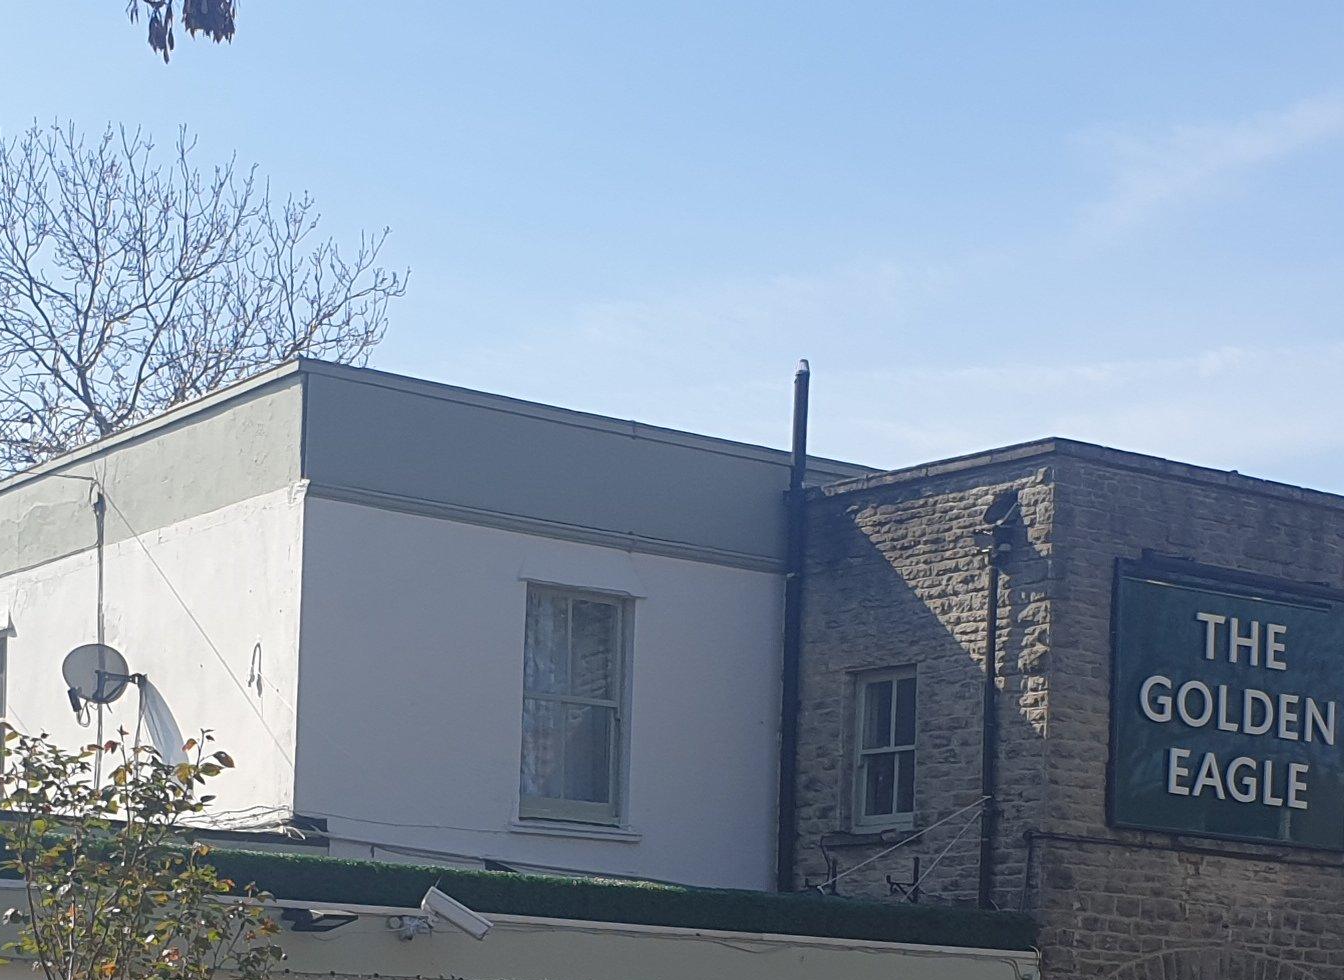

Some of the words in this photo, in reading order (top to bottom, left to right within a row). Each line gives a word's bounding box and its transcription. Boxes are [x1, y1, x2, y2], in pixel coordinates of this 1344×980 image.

[1196, 611, 1287, 670] THE
[1139, 675, 1336, 746] GOLDEN
[1168, 747, 1309, 810] EAGLE
